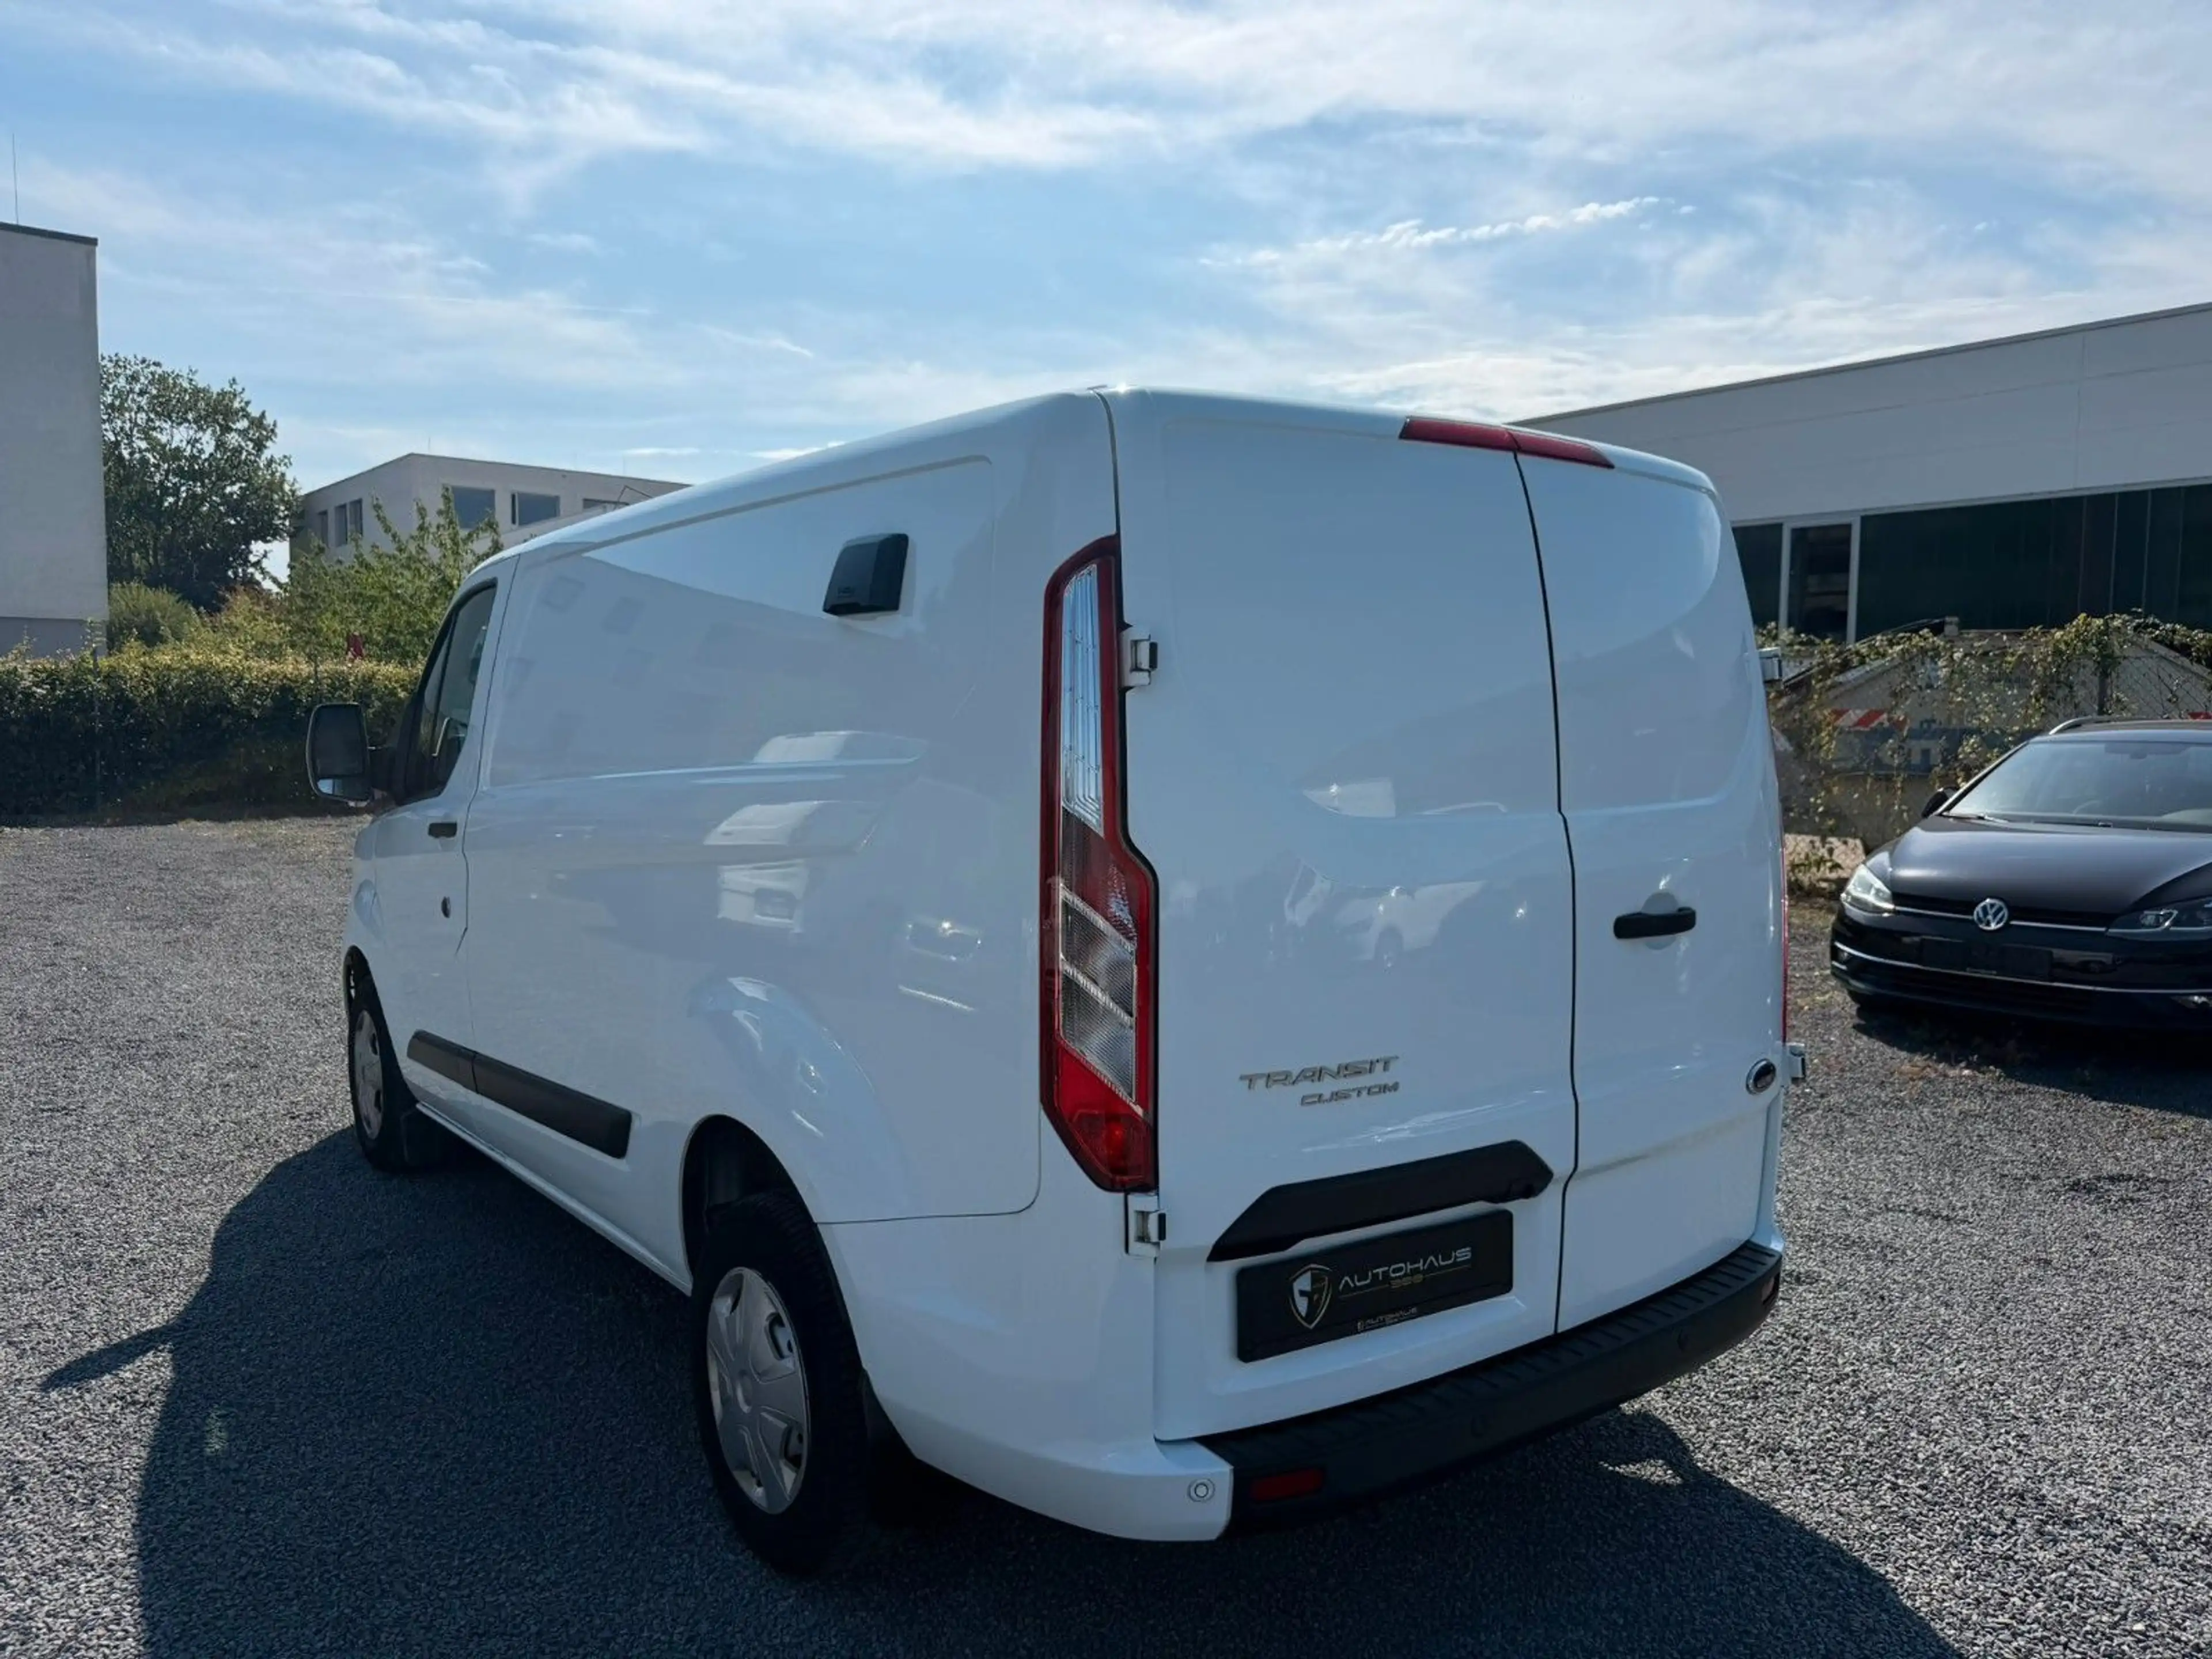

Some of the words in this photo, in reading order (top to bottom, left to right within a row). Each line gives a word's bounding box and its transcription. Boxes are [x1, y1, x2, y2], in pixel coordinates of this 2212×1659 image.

[1240, 1055, 1399, 1090] TRANSIT
[1301, 1081, 1399, 1106] CUSTOM
[1339, 1247, 1472, 1291] AUTOHAUS
